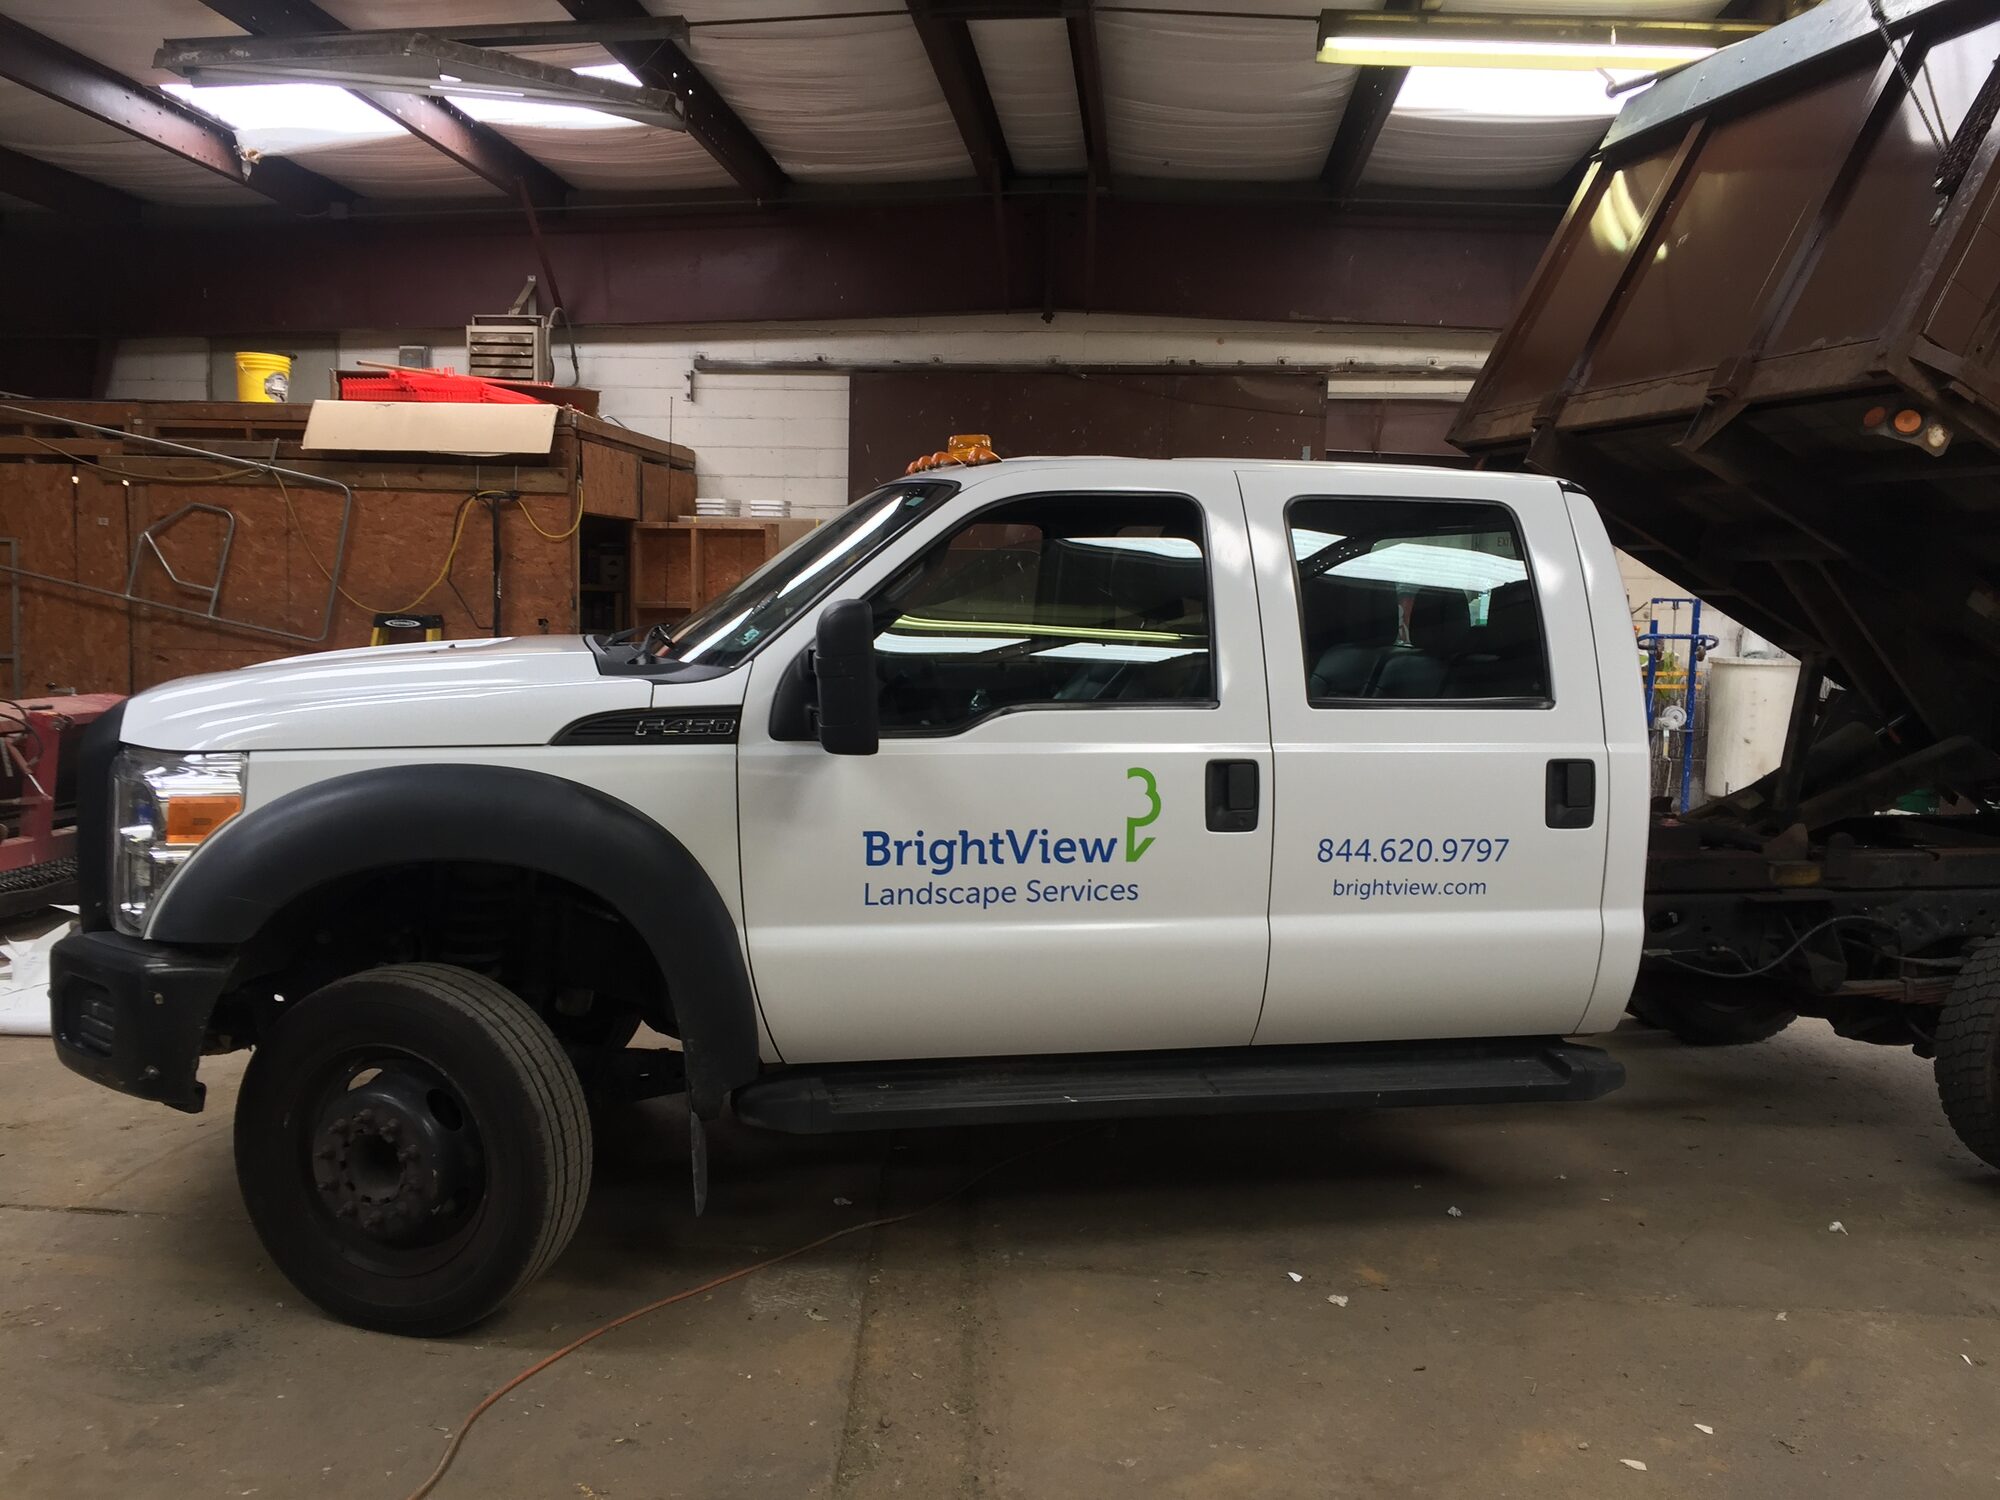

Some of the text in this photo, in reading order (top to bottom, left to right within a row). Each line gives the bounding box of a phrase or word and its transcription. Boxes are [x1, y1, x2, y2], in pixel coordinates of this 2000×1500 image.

[863, 829, 1118, 876] BrightView
[1317, 838, 1510, 863] 844.620.9797
[864, 879, 1139, 909] Landscape Services
[1333, 878, 1487, 900] brightview.com
